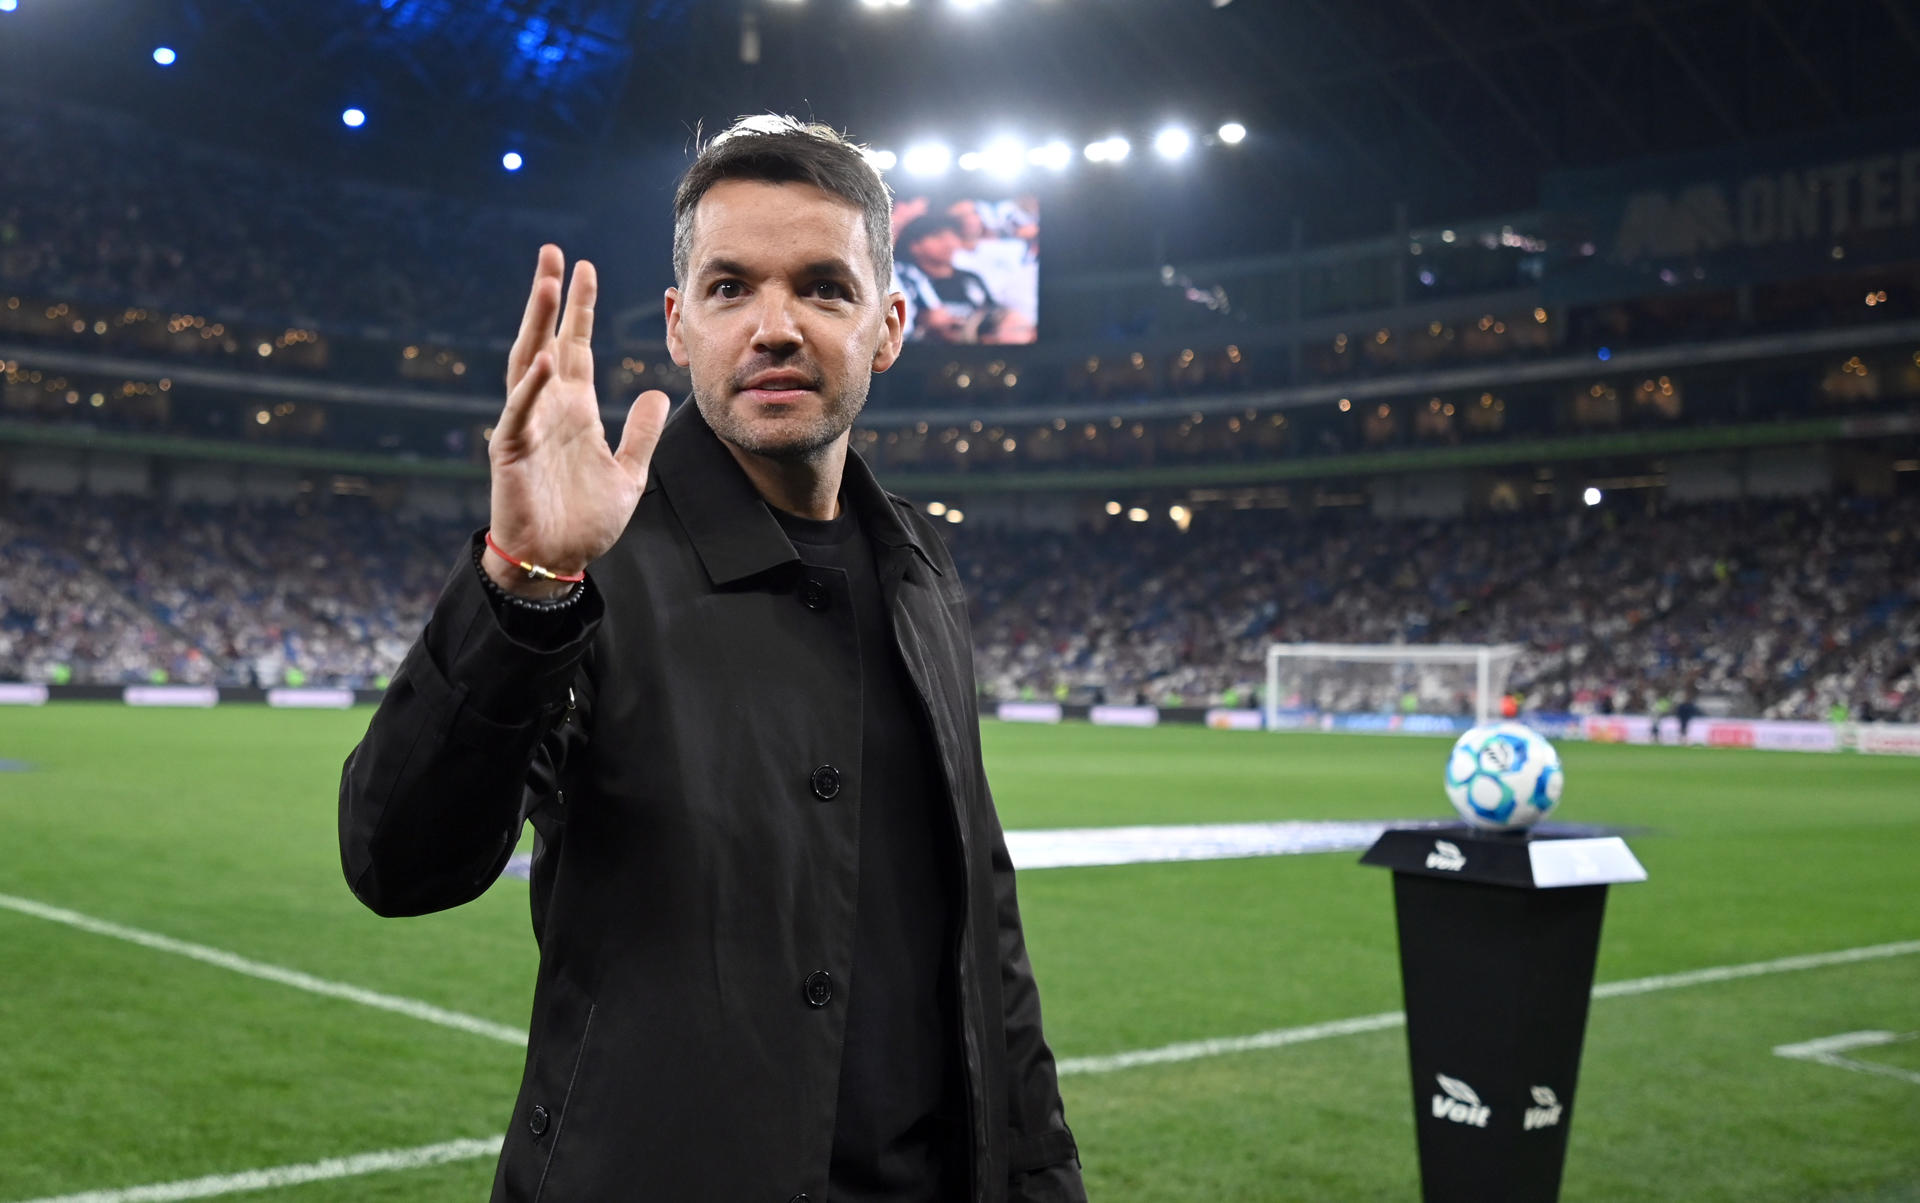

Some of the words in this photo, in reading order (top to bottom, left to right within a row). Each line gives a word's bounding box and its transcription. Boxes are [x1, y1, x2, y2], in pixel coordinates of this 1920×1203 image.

[1425, 852, 1467, 872] Voit
[1432, 1094, 1491, 1128] Voit
[1523, 1104, 1563, 1131] Voit
